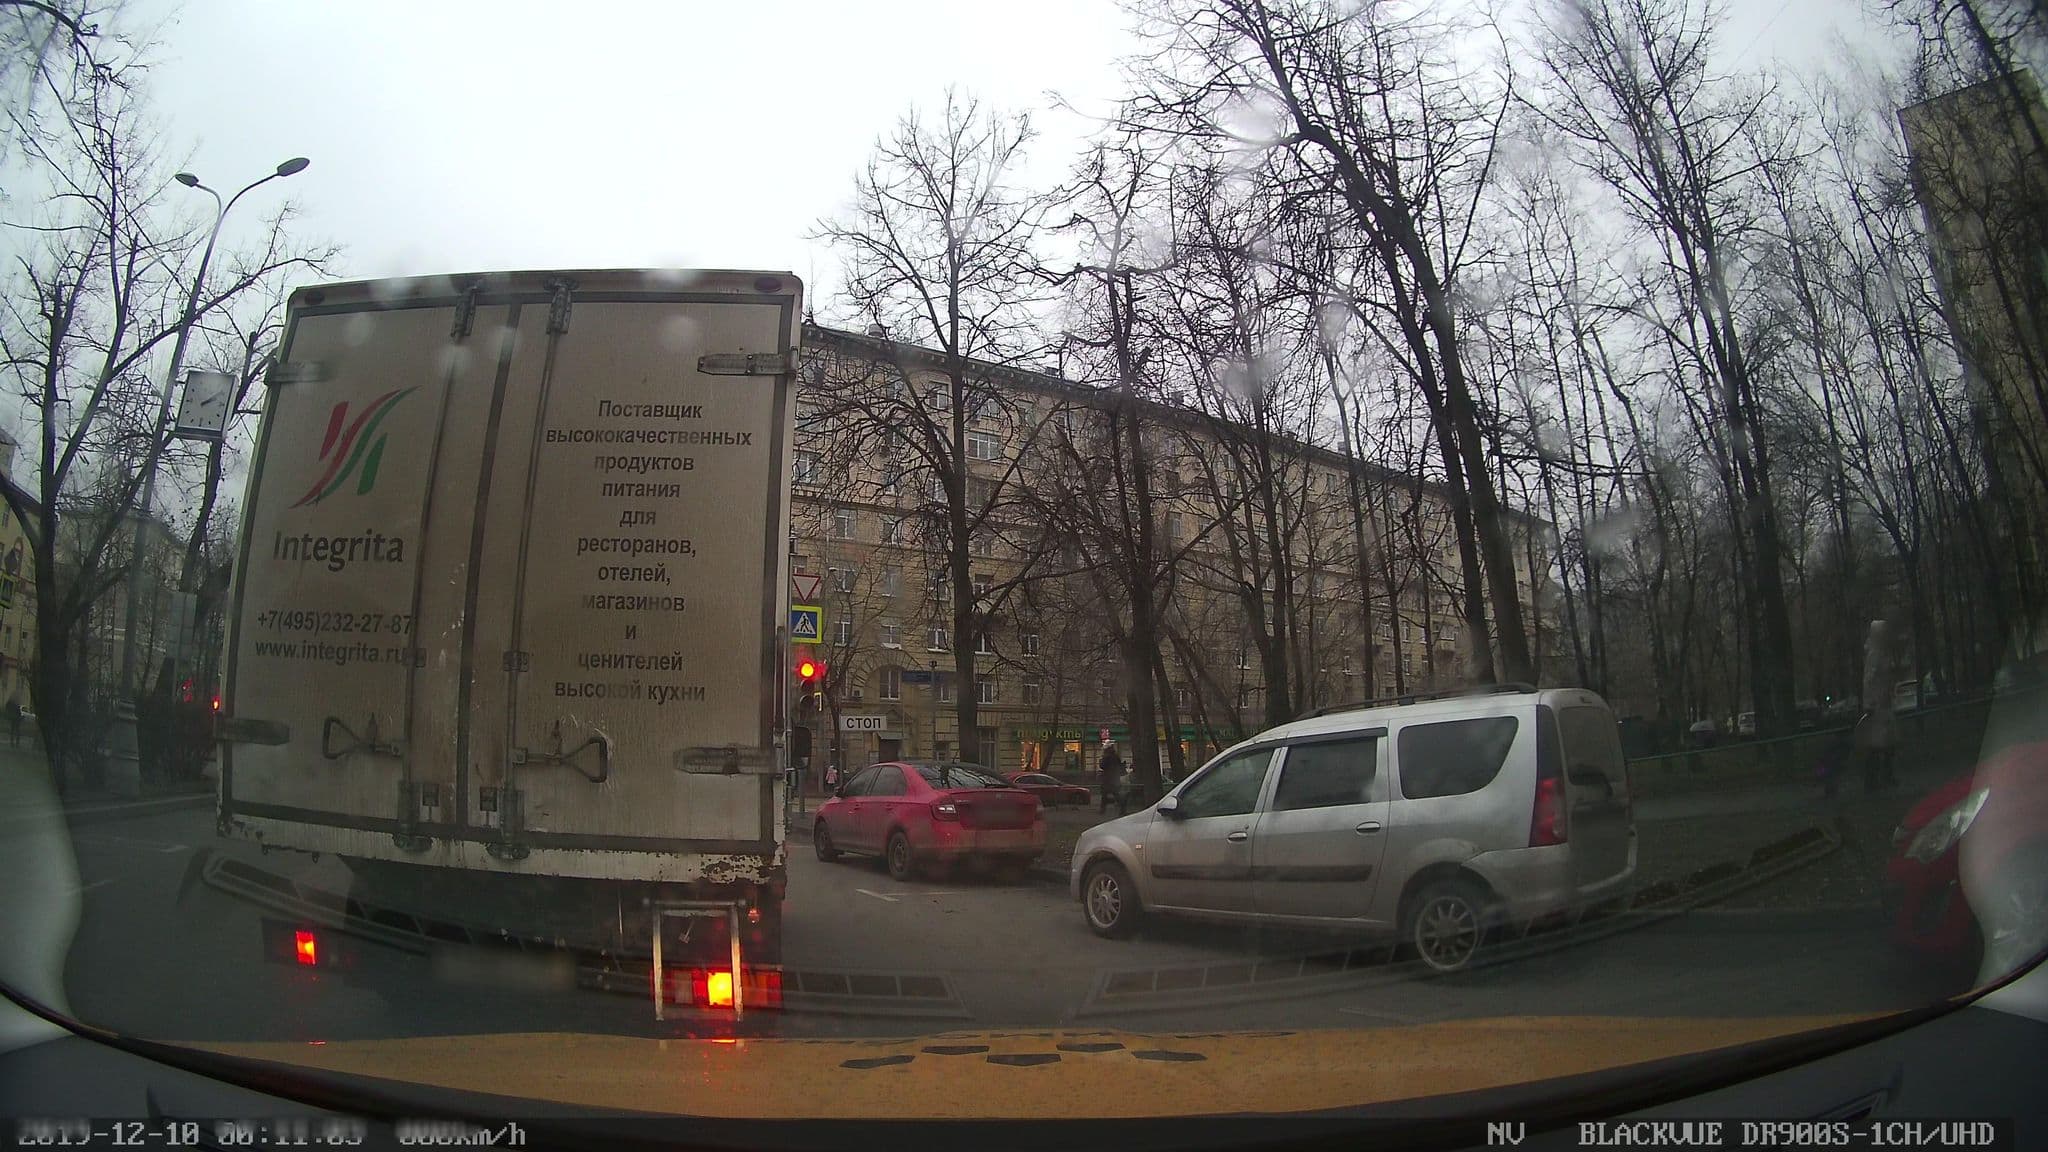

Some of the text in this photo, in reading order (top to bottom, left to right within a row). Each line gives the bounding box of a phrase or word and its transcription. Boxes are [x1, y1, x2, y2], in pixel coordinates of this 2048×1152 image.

[598, 400, 702, 421] Поставщик
[546, 428, 752, 446] высококачественных
[594, 455, 694, 474] продуктов
[602, 483, 681, 498] питания
[620, 511, 656, 528] для
[273, 528, 404, 573] Integrita
[577, 537, 696, 558] ресторанов,
[598, 563, 671, 586] отелей,
[582, 593, 685, 612] магазинов
[258, 610, 415, 637] +7(495)232-27-87
[625, 625, 637, 640] и
[256, 639, 407, 666] www.integrita.ru
[579, 651, 683, 671] ценителей
[555, 680, 705, 705] высокой кухни
[846, 717, 882, 729] СТОП
